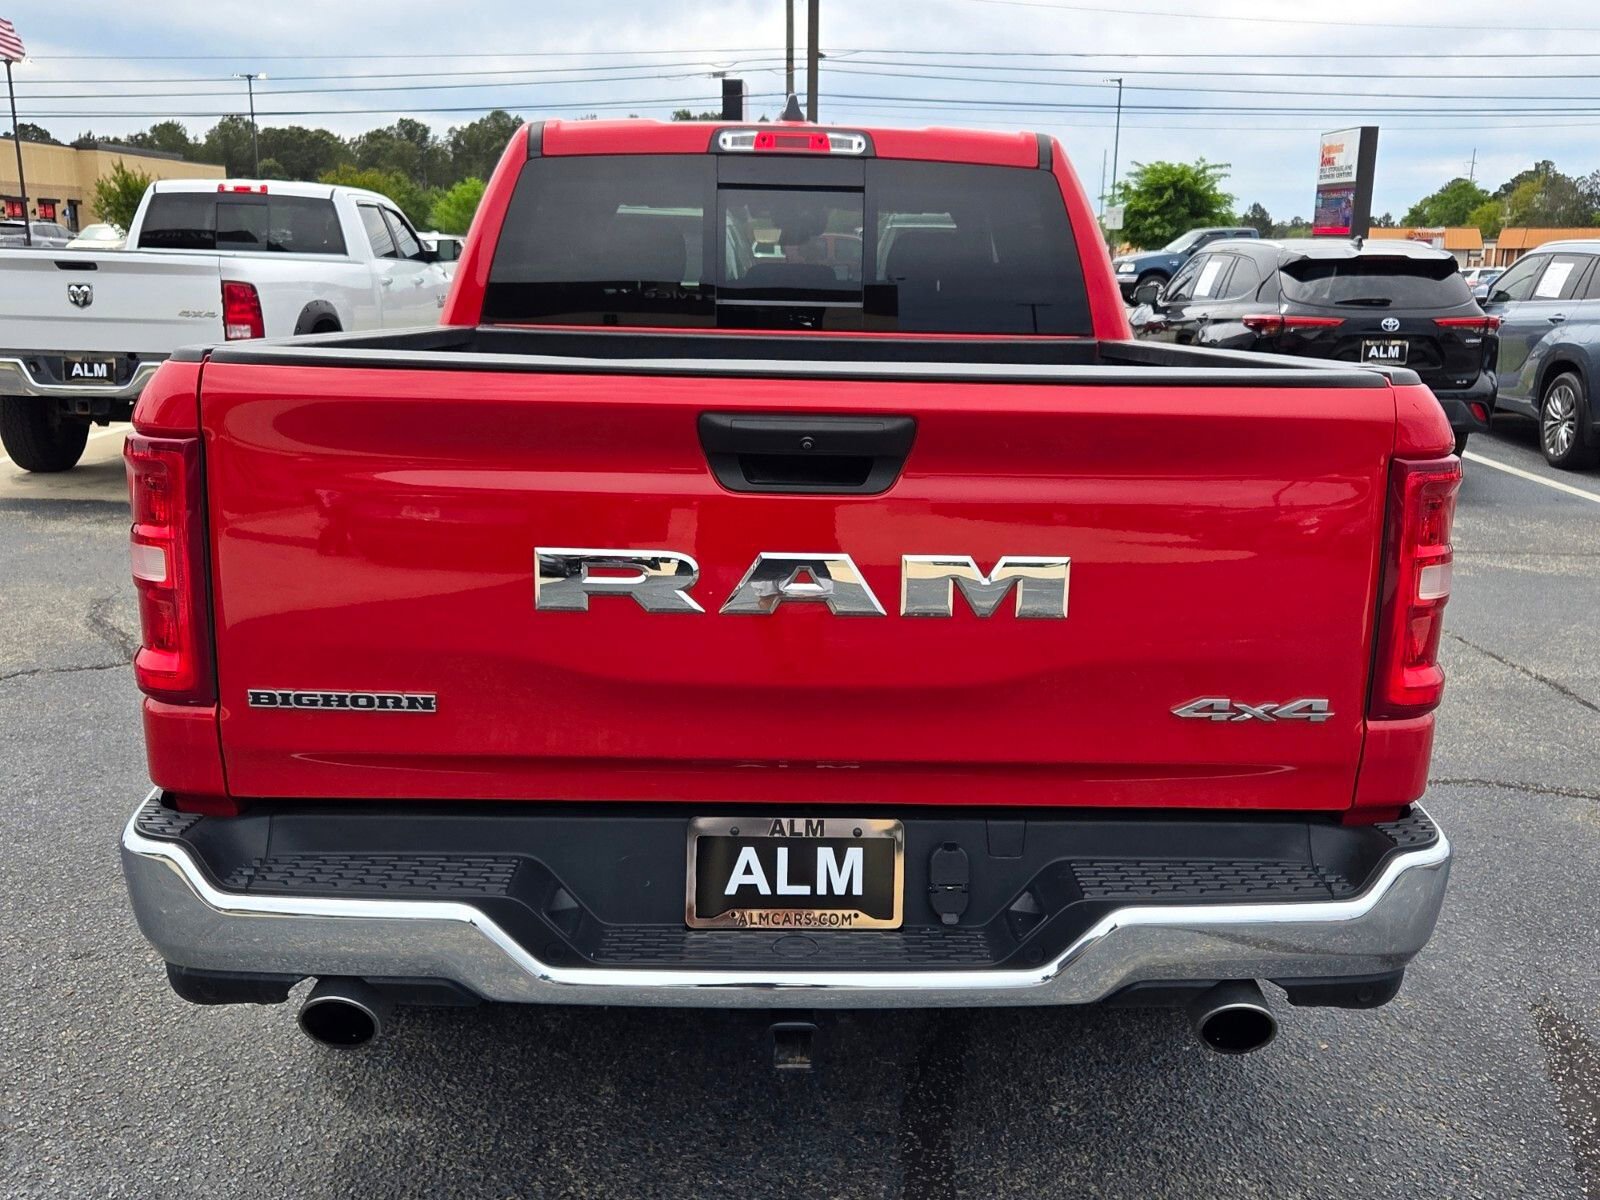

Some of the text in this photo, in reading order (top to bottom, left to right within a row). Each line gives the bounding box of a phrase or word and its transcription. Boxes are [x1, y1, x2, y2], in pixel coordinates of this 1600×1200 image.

[1368, 345, 1400, 358] ALM
[71, 363, 107, 377] ALM
[534, 547, 1070, 618] RAM
[247, 688, 437, 713] BIGHORN
[1172, 697, 1335, 722] 4x4
[769, 819, 825, 836] ALM
[724, 846, 864, 896] ALM
[737, 910, 853, 927] ALMCARS.COM
